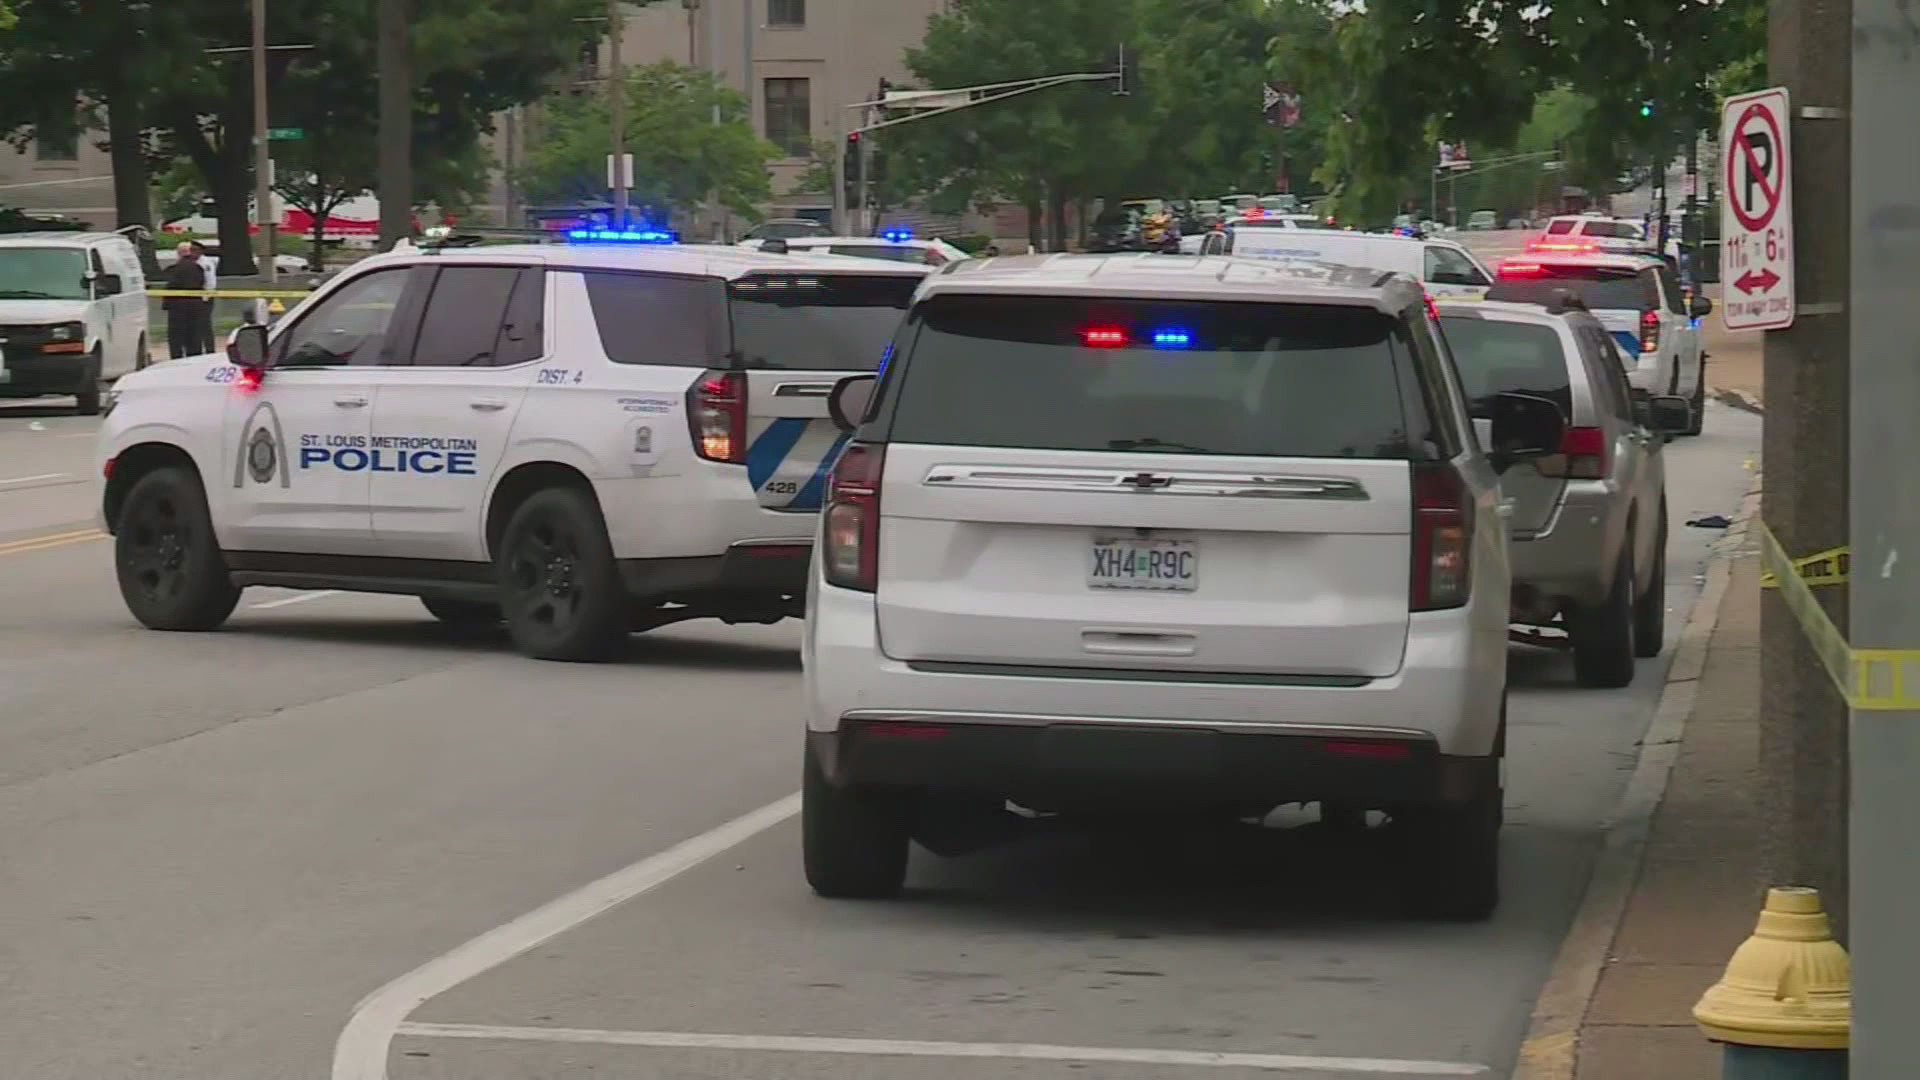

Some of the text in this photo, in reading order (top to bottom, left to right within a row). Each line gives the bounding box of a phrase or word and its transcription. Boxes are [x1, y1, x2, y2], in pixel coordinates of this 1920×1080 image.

[1766, 228, 1777, 261] 6
[1727, 302, 1744, 317] TOW
[206, 367, 237, 383] 428
[537, 368, 584, 385] DIST. 4
[300, 434, 478, 451] ST. LOUIS METROPOLITAN
[300, 448, 478, 475] POLICE
[766, 482, 797, 494] 428
